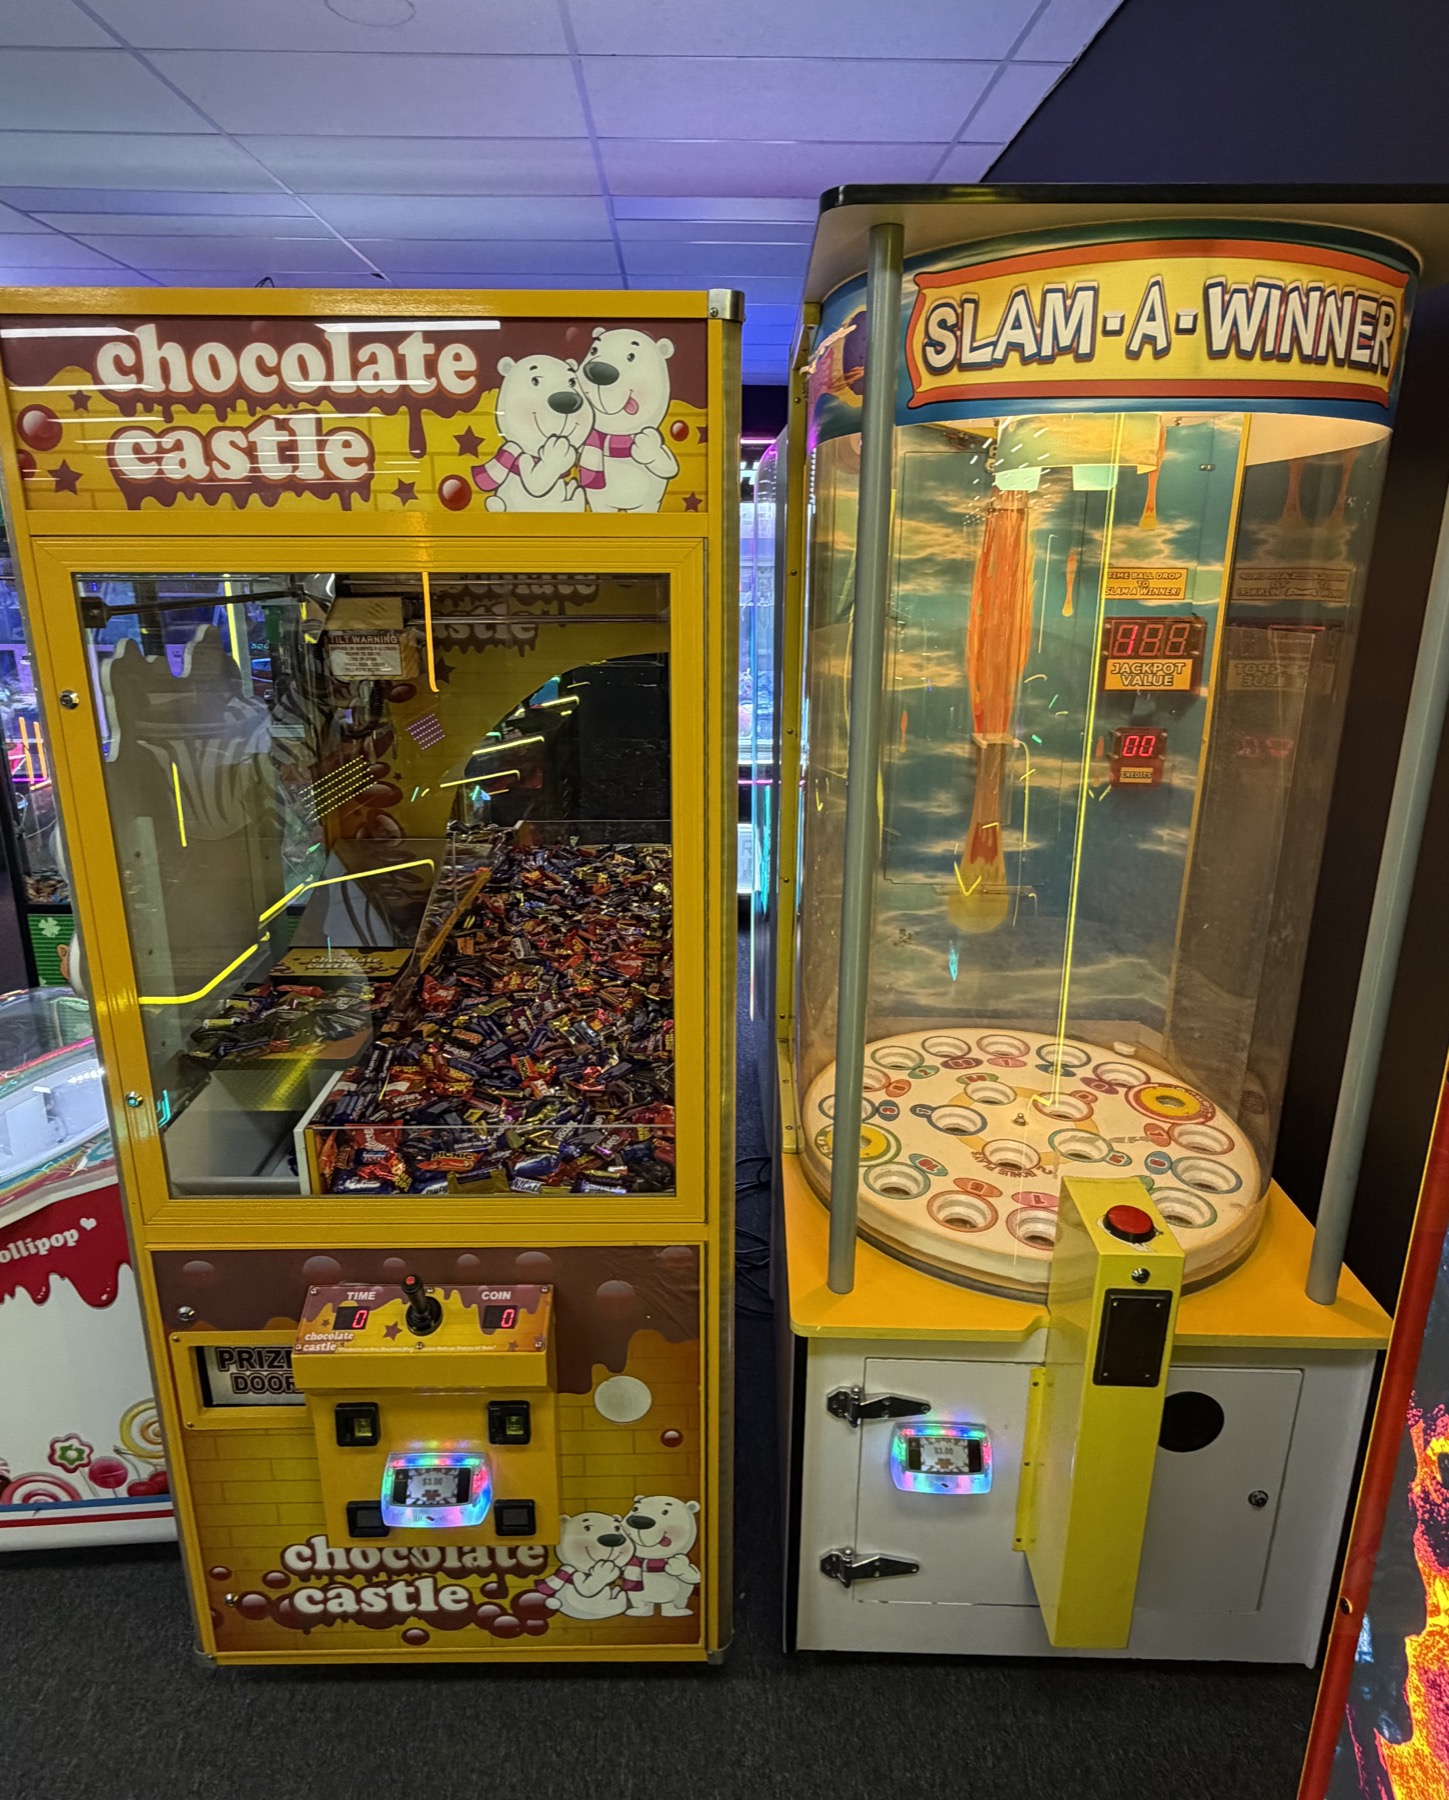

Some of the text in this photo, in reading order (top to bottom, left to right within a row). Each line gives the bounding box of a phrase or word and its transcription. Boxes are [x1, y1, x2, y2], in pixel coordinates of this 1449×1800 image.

[96, 323, 478, 395] chocolate
[113, 412, 369, 481] castle
[1131, 572, 1155, 580] BALL
[1156, 572, 1182, 580] DROP
[1137, 580, 1150, 588] TO
[1104, 587, 1181, 596] SLAM A WINNER!
[330, 634, 398, 644] TILT WARNING
[1111, 663, 1186, 675] JACKPOT
[1121, 675, 1174, 687] VALUE
[1122, 735, 1156, 757] 00
[432, 1152, 474, 1160] PICNIC
[347, 1291, 377, 1301] TIME
[481, 1291, 512, 1301] COIN
[351, 1309, 368, 1329] 0
[500, 1308, 518, 1329] 0
[304, 1331, 355, 1342] chocolate
[303, 1342, 337, 1352] castle
[284, 1535, 545, 1571] chocolate
[293, 1577, 470, 1613] castle
